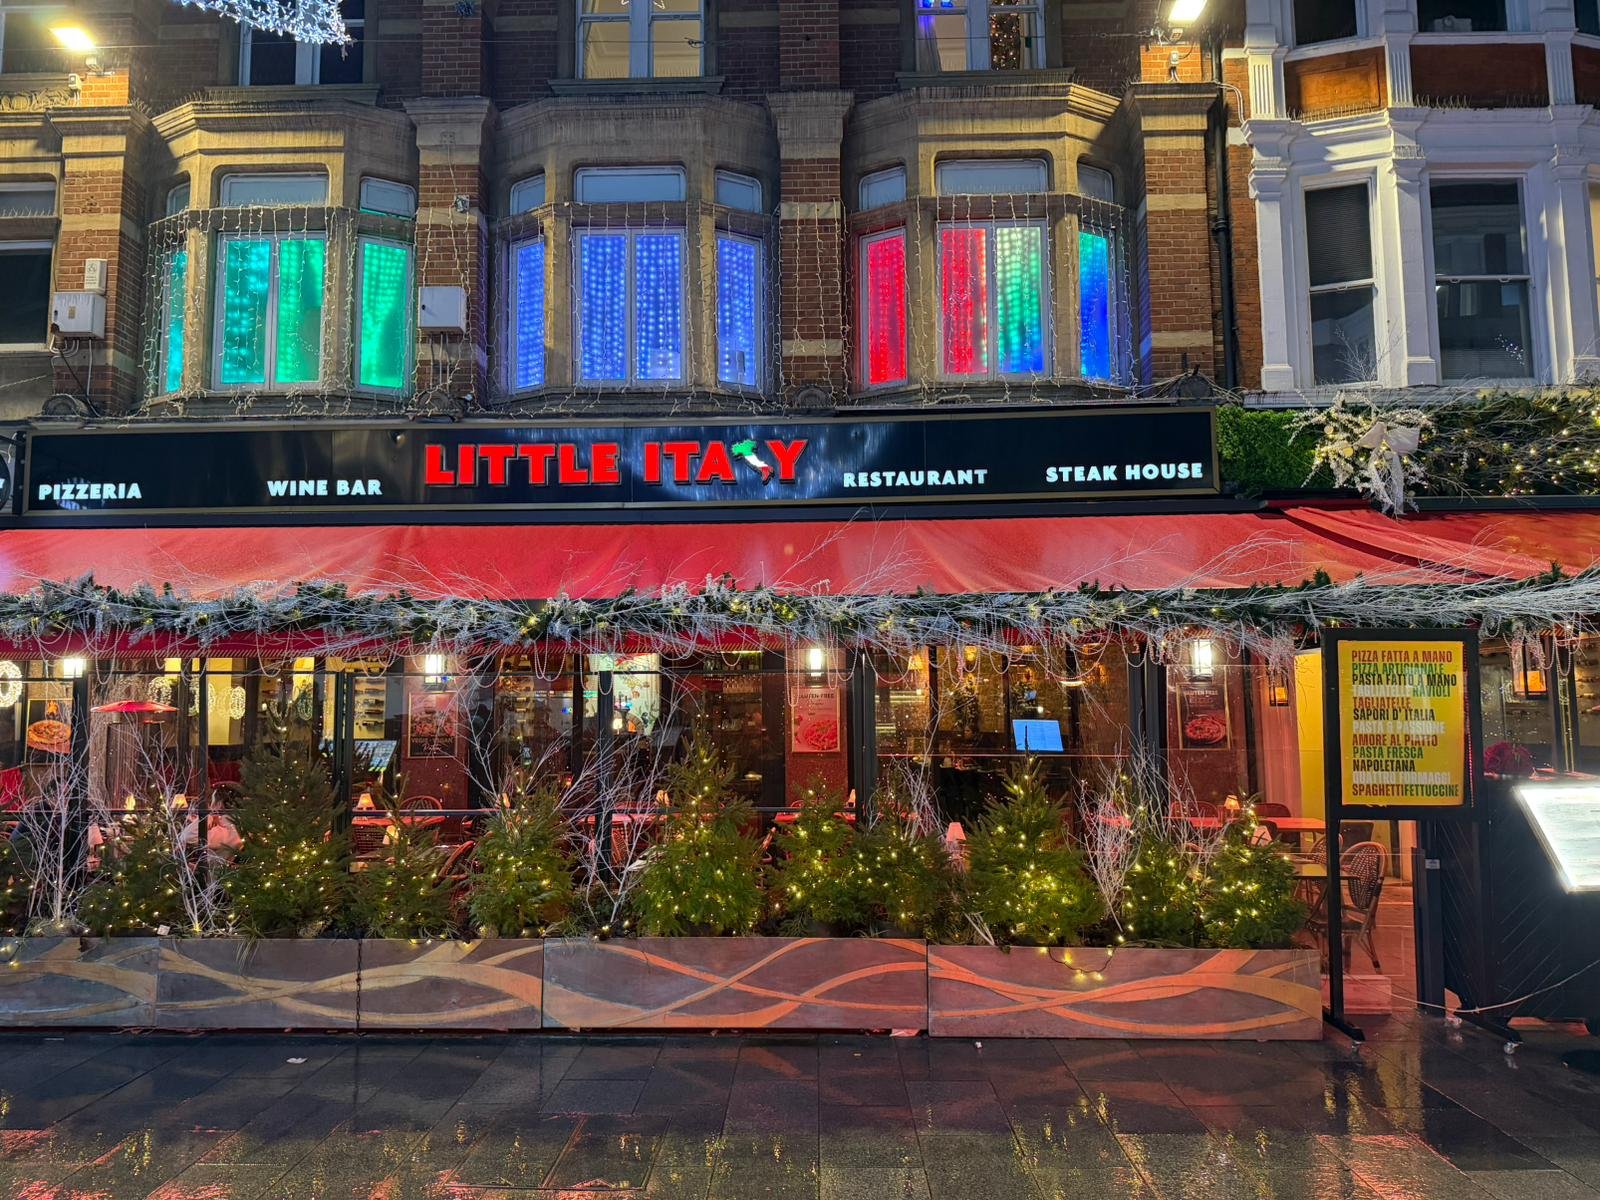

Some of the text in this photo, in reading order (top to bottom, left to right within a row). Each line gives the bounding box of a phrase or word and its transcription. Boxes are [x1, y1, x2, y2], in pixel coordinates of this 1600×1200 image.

[425, 443, 620, 485] LITTLE
[843, 469, 988, 488] RESTAURANT
[1046, 462, 1203, 483] STEAK HOUSE
[39, 483, 142, 500] PIZZERIA
[267, 479, 383, 497] WINE BAR
[1352, 651, 1452, 662] PIZZA FATTA A MANO
[1352, 663, 1444, 675] PIZZA ARTIGIANALE
[1352, 674, 1457, 686] PASTA FATTO A MANO
[1412, 685, 1450, 697] RAVIOLI
[1353, 697, 1411, 709] TAGLIATELLE
[1353, 709, 1389, 721] SAPORI
[1405, 709, 1435, 721] ITALIA
[1352, 734, 1438, 747] AMORE AL PIATTO
[1353, 746, 1424, 759] PASTA FRESCA
[1353, 759, 1416, 772] NAPOLETANA
